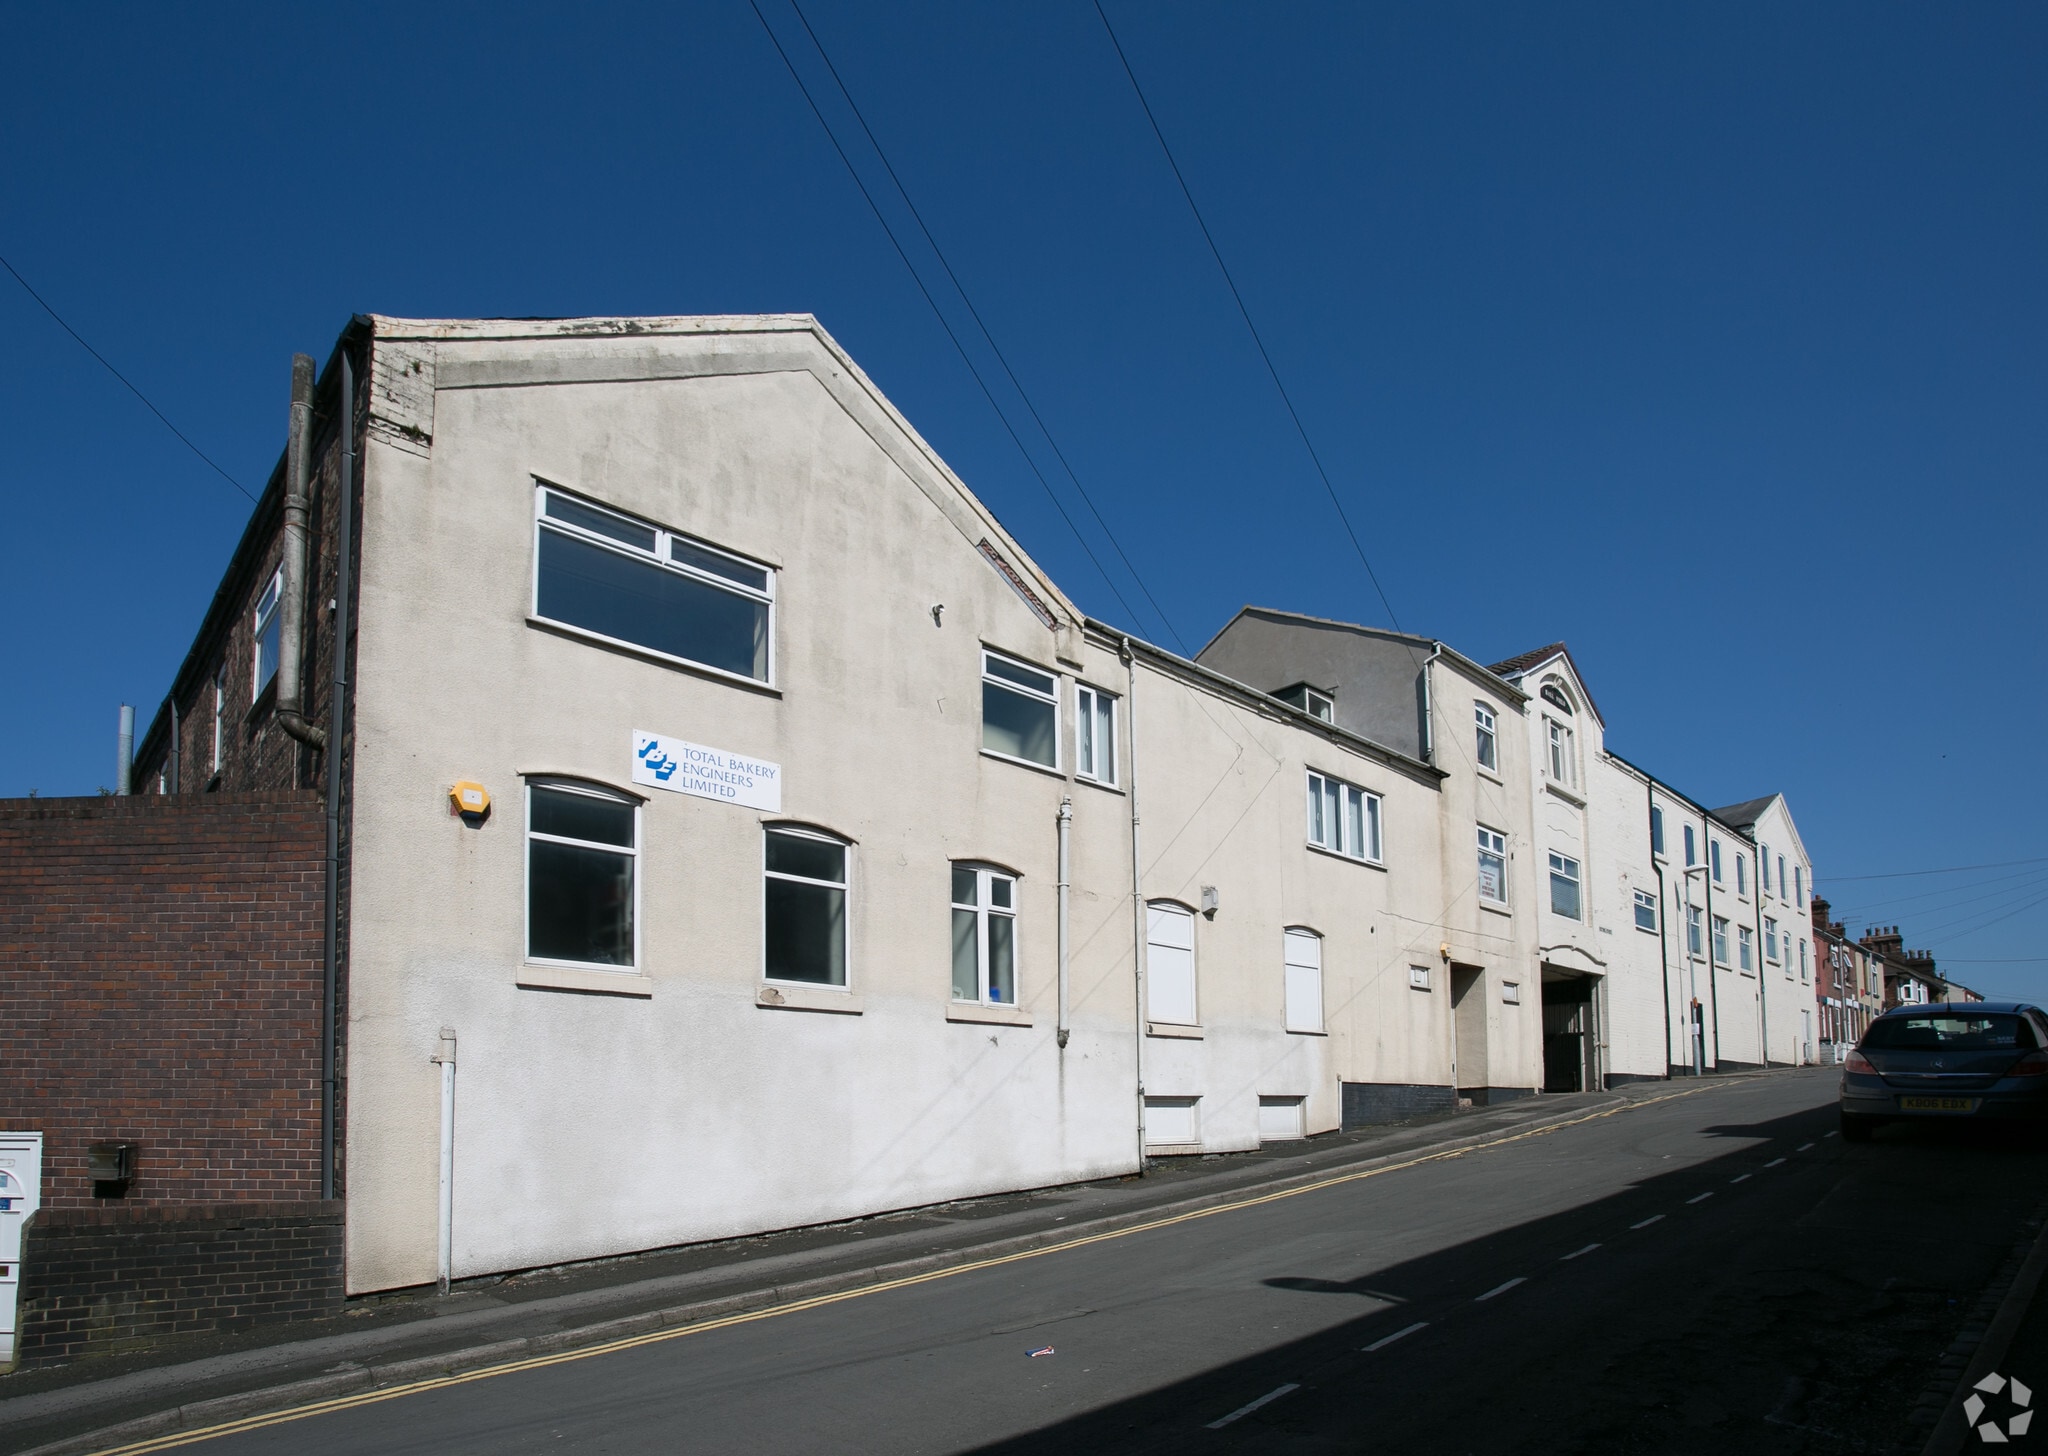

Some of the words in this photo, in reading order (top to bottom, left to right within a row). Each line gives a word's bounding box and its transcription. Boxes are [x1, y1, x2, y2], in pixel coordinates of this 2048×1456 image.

[683, 748, 724, 767] TOTAL
[730, 759, 776, 779] BAKERY
[683, 762, 753, 788] ENGINEERS
[683, 777, 736, 798] LIMITED
